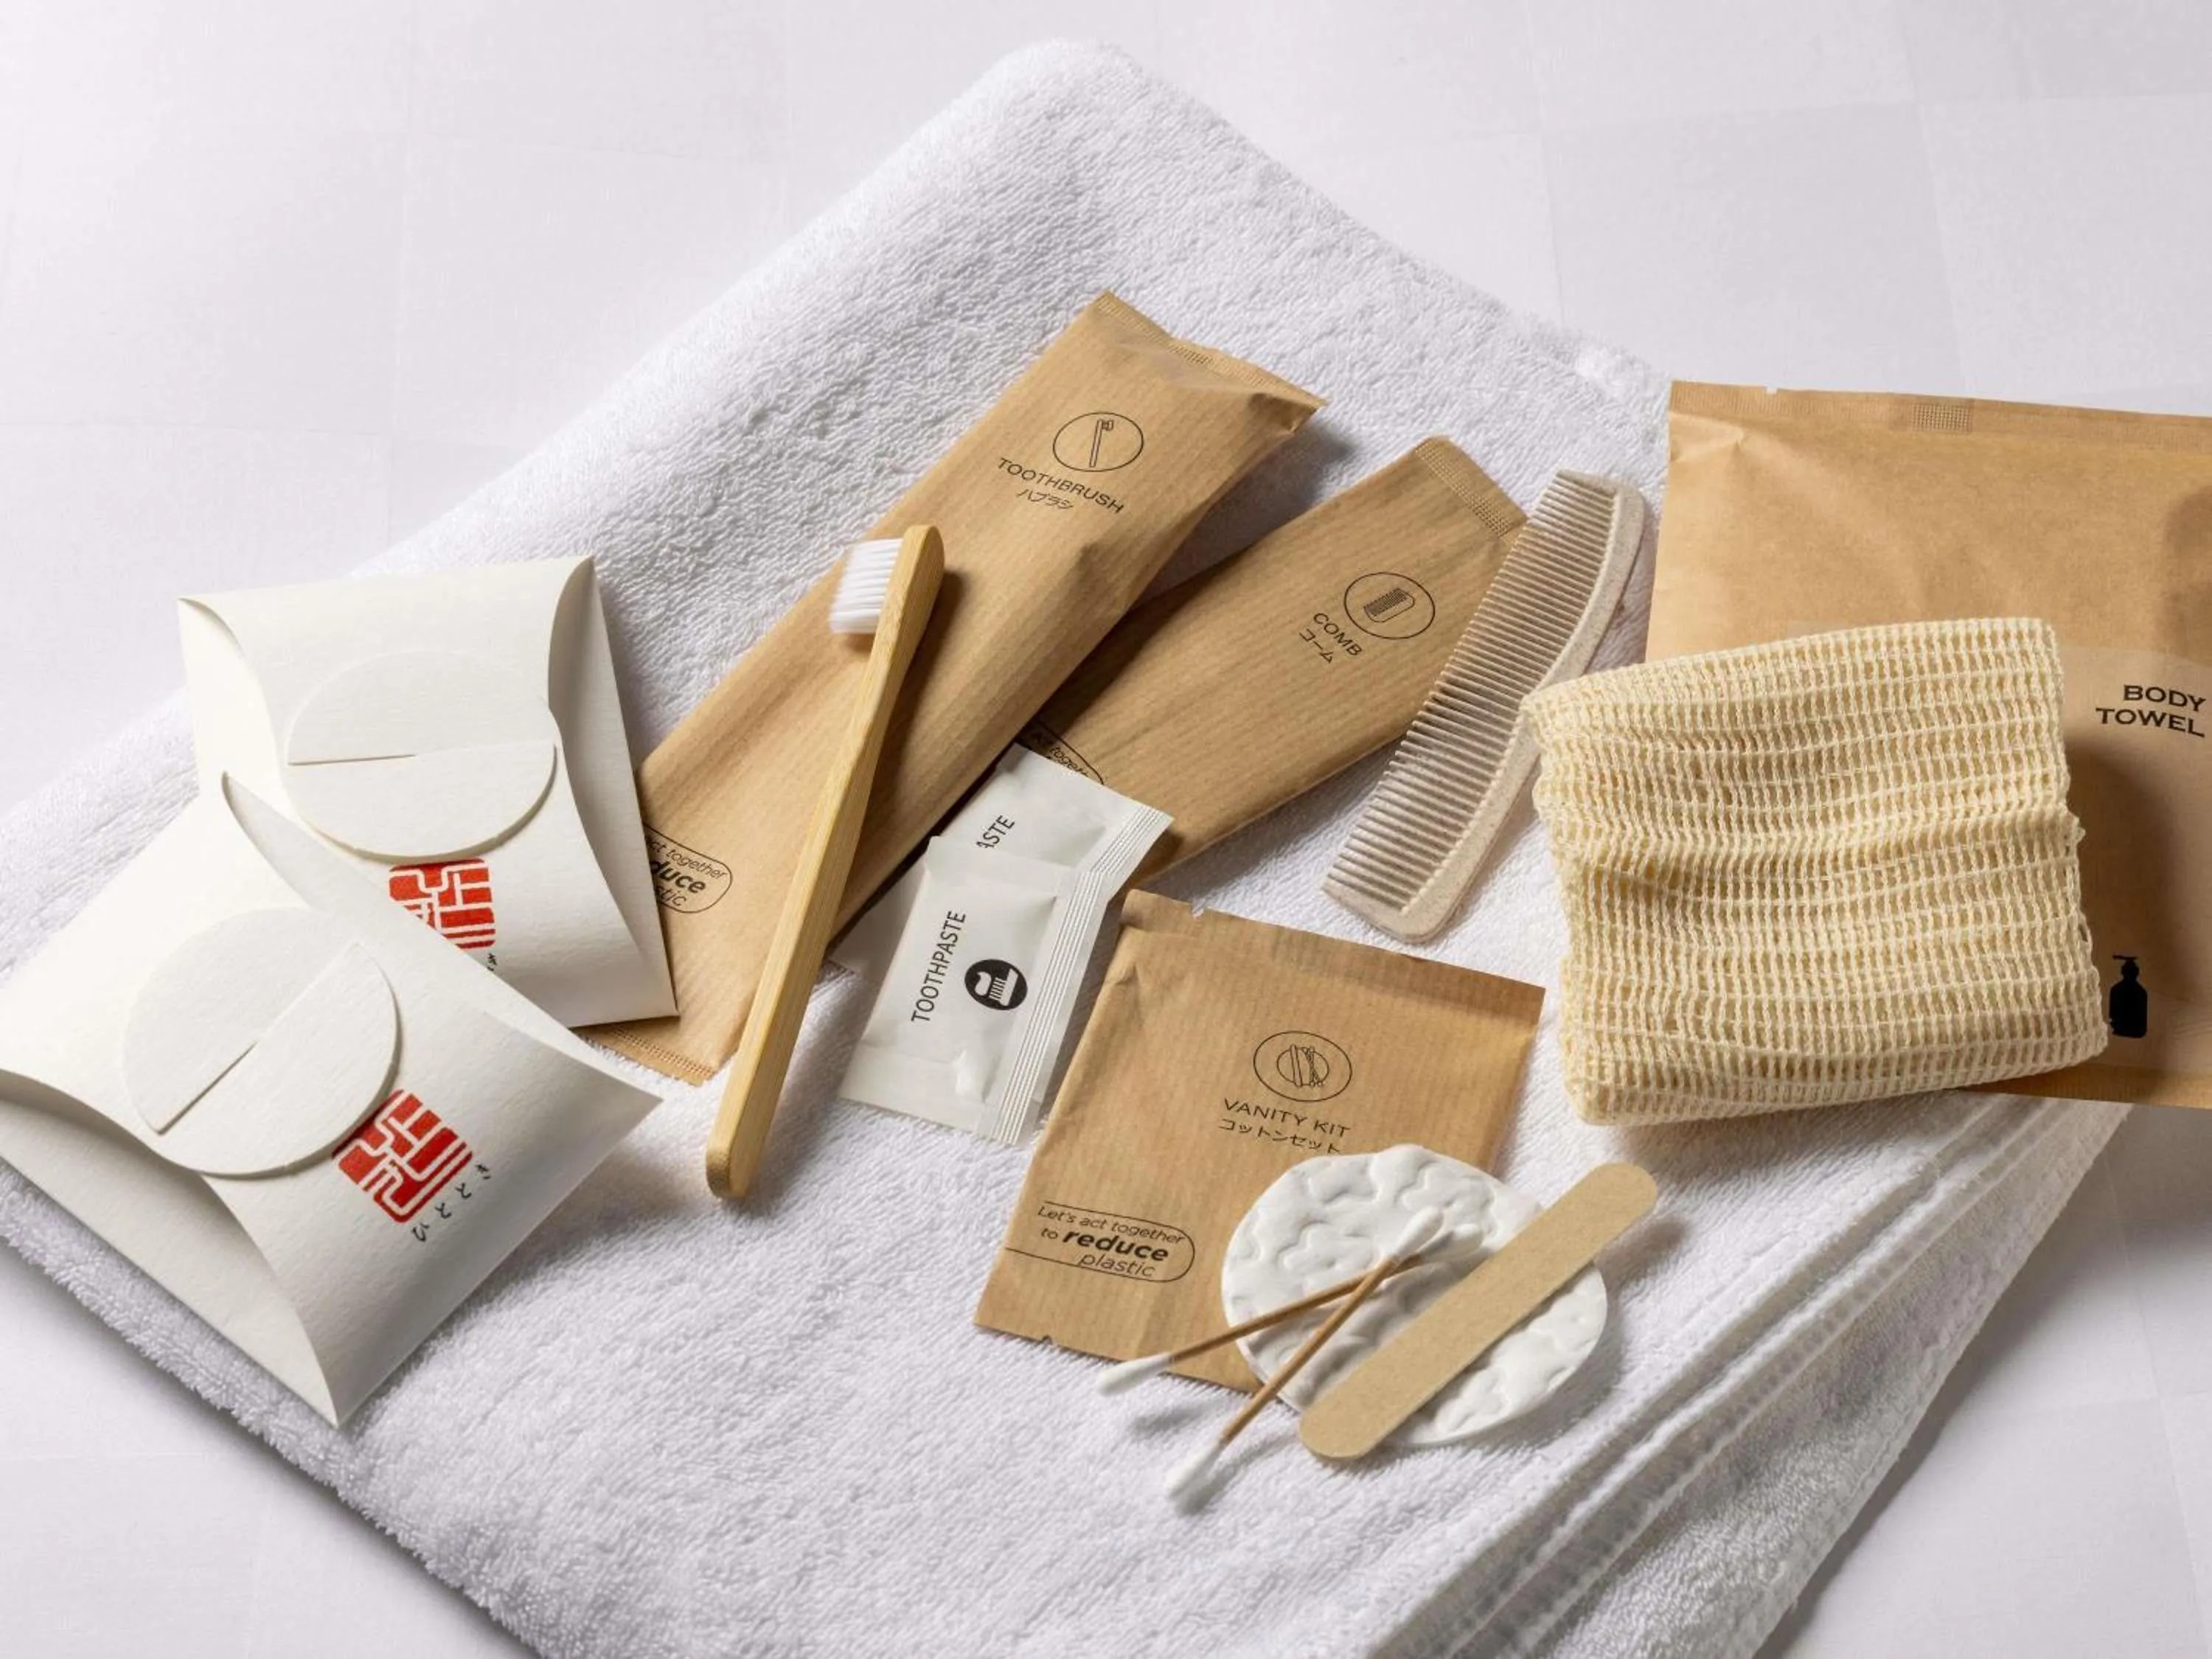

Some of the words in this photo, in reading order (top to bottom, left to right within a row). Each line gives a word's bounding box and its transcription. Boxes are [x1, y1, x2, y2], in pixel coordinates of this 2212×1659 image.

[998, 457, 1124, 513] TOOTHBRUSH
[1016, 489, 1074, 509] ハブラシ
[1298, 628, 1334, 664] コーム
[1313, 613, 1363, 655] COMB
[2123, 684, 2206, 712] BODY
[2096, 708, 2205, 737] TOWEL
[649, 860, 706, 894] duce
[666, 849, 727, 880] together
[911, 911, 966, 1023] TOOTHPASTE
[1224, 1097, 1308, 1127] VANITY
[1313, 1119, 1351, 1138] KIT
[1218, 1118, 1342, 1155] コットンセット
[411, 1163, 492, 1242] ひととき
[1037, 1206, 1075, 1225] Let's
[1079, 1217, 1108, 1230] act
[1110, 1220, 1186, 1245] together
[1040, 1227, 1060, 1240] to
[1062, 1229, 1169, 1262] reduce
[1077, 1253, 1156, 1279] plastic
